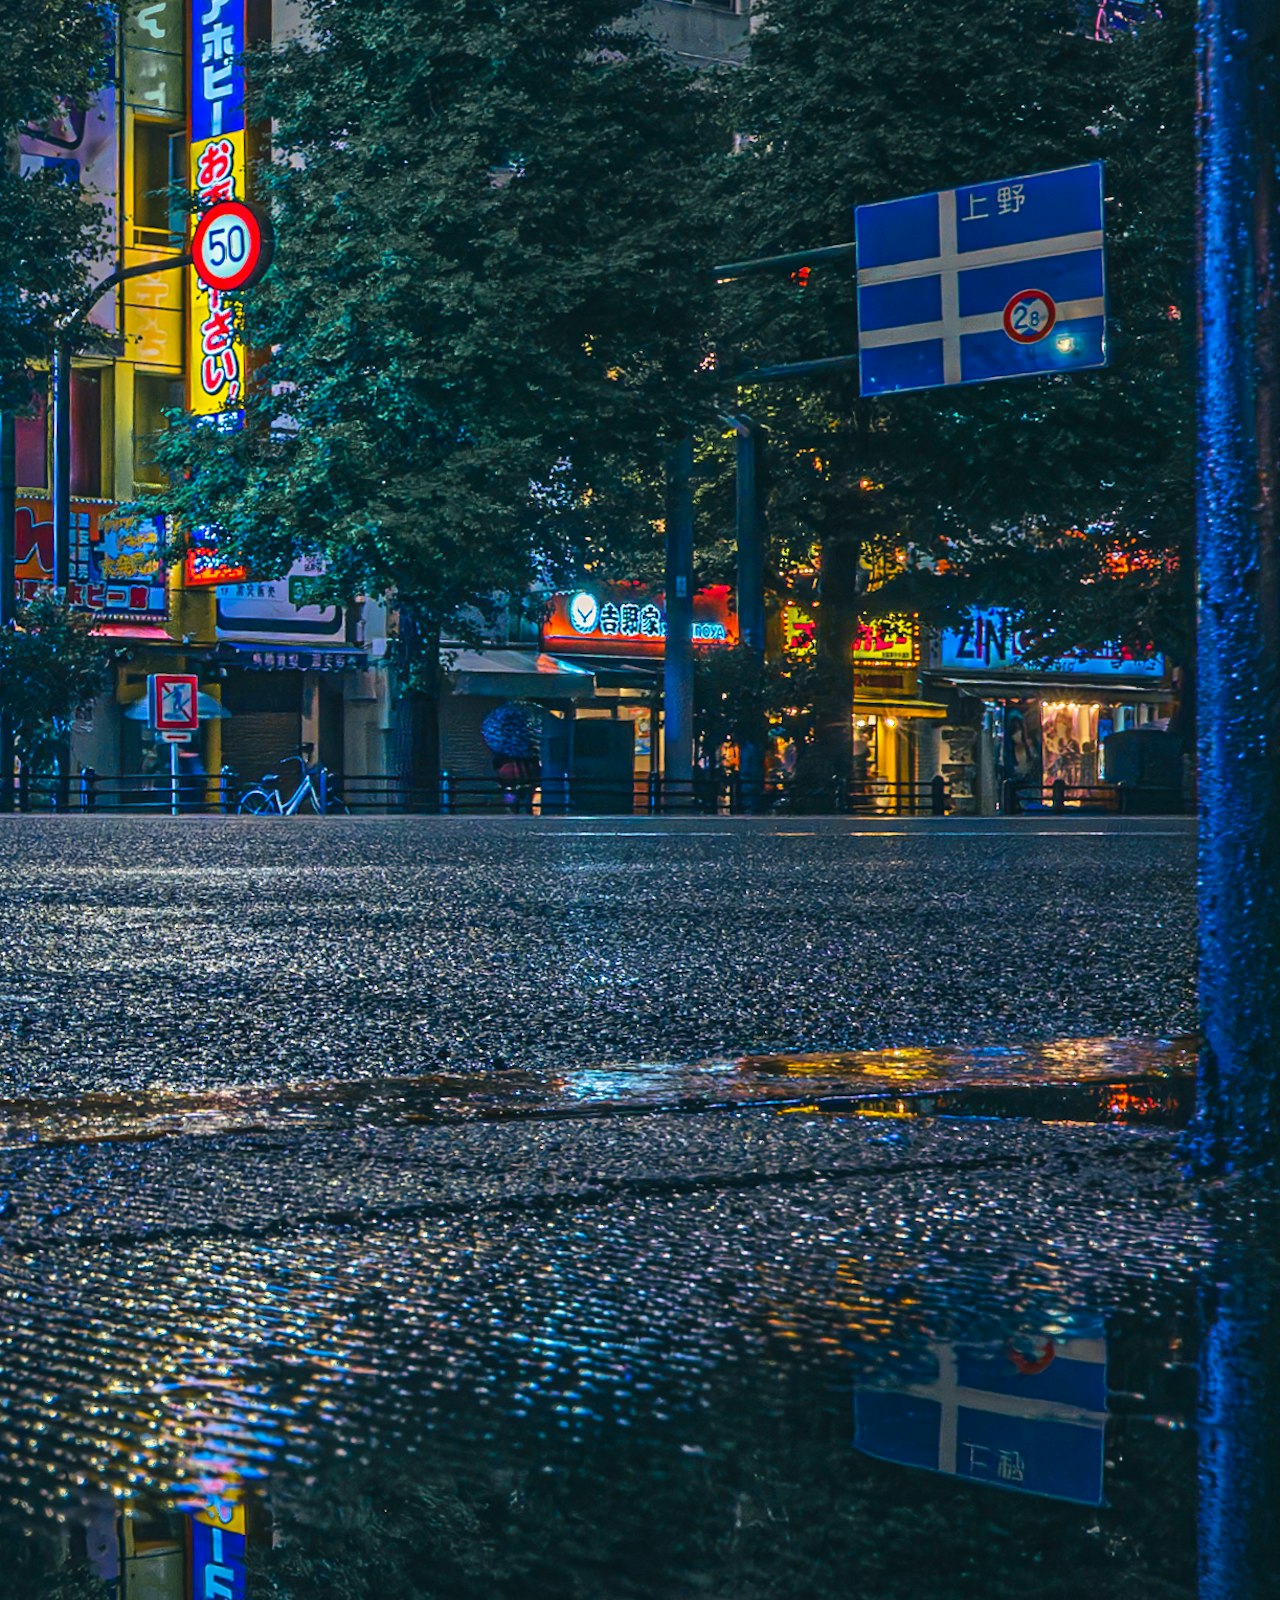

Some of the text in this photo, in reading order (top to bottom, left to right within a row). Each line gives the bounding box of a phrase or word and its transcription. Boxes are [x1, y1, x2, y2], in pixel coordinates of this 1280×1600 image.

[960, 183, 1026, 222] 上野
[208, 224, 247, 267] 50
[601, 602, 661, 637] 吉野家
